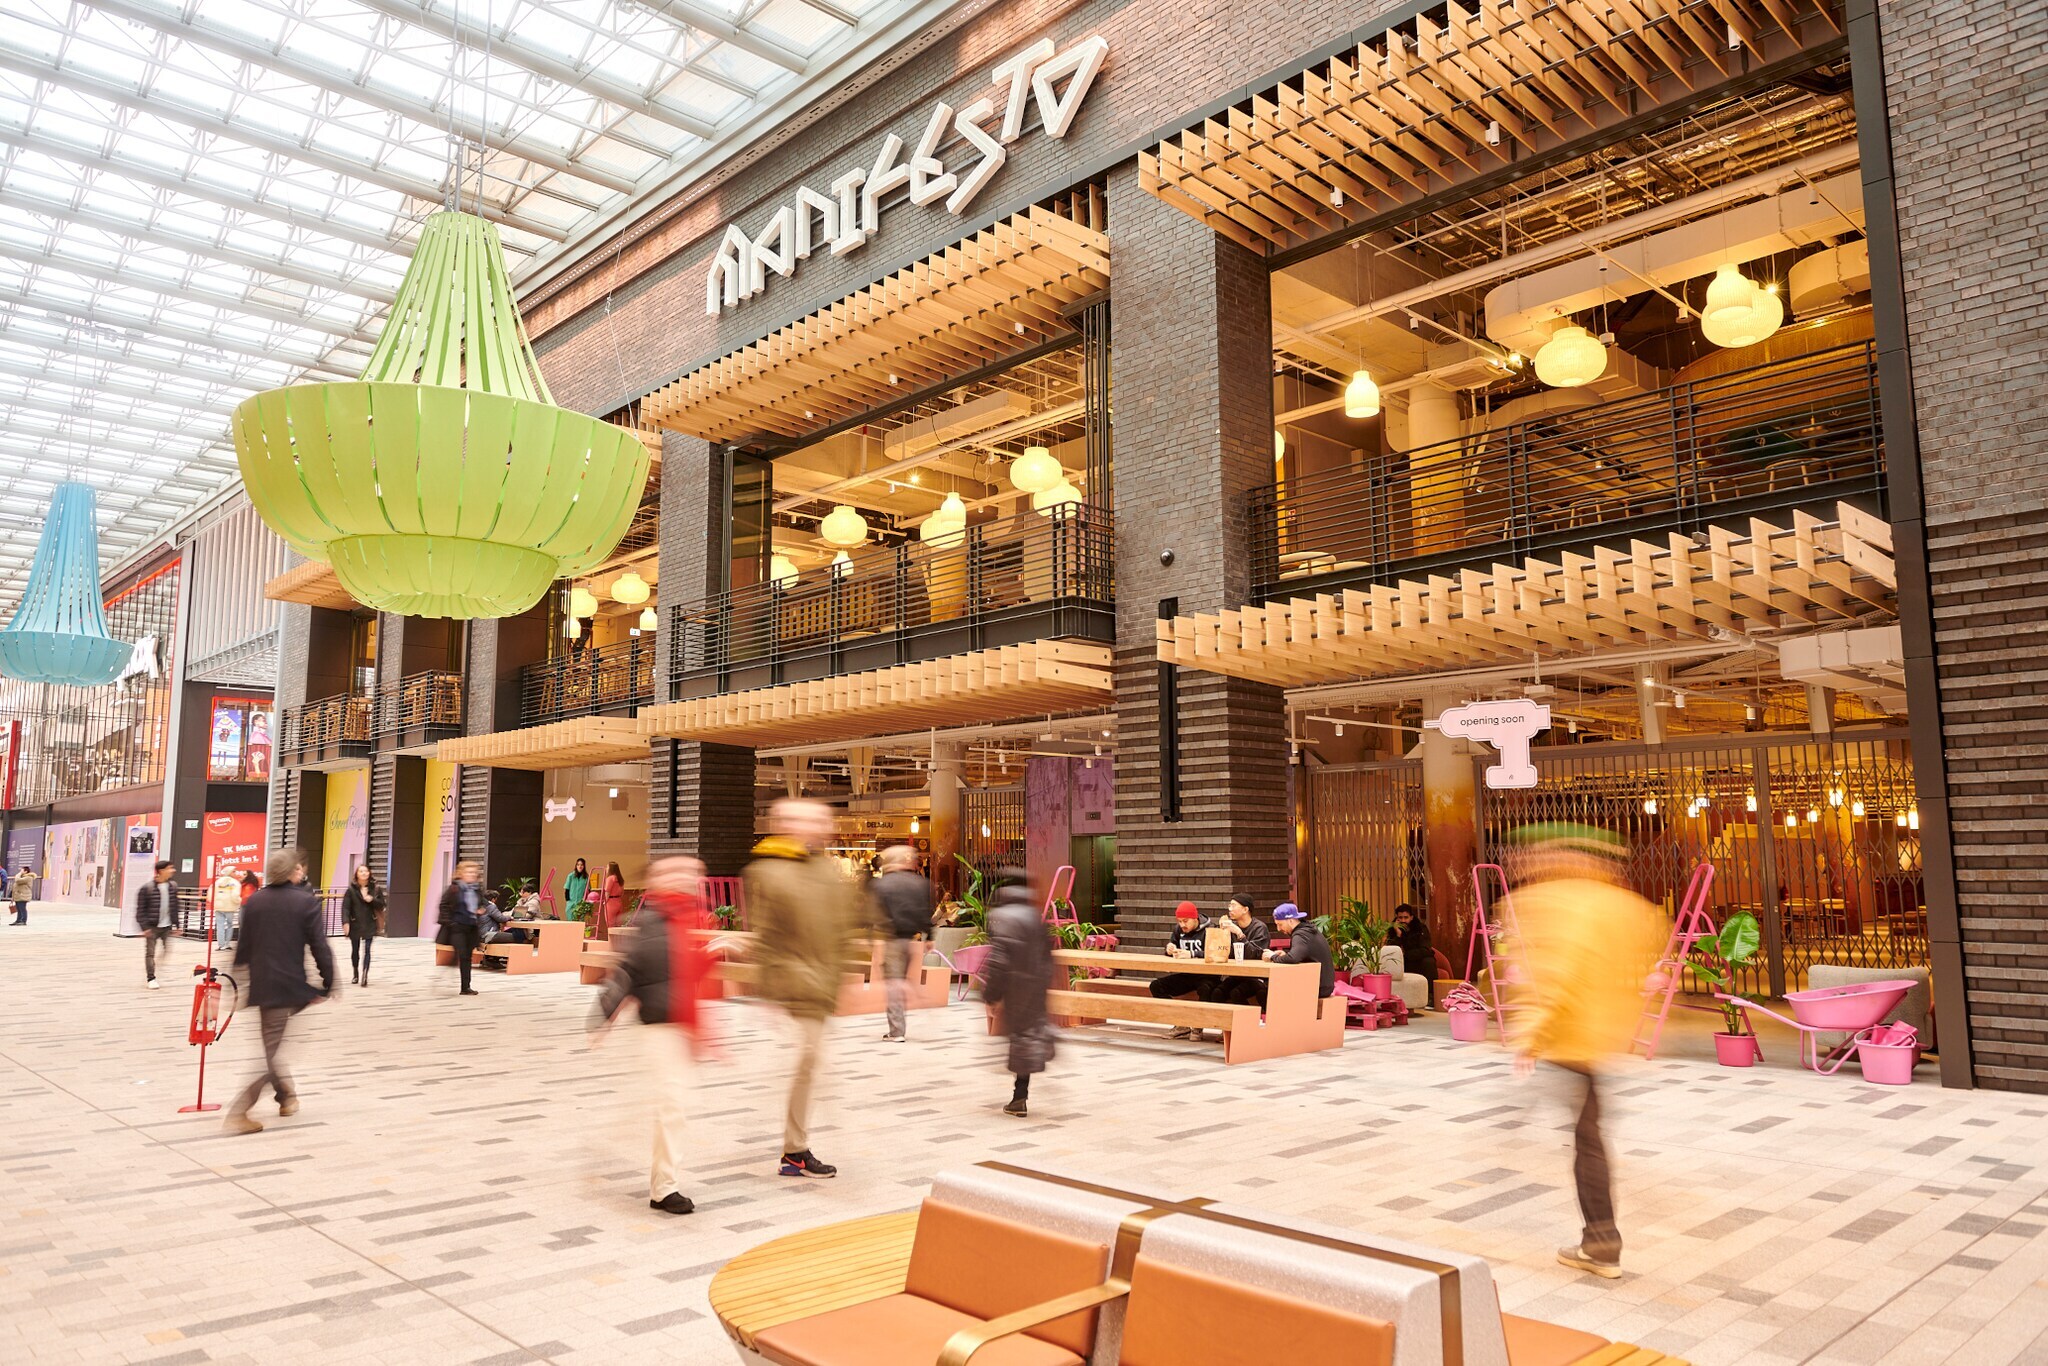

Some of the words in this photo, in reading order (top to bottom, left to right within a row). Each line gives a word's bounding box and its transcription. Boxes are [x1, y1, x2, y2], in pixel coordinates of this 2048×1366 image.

[706, 34, 1109, 317] MANIFESTO
[1460, 716, 1499, 727] opening
[1501, 715, 1524, 723] soon
[441, 778, 456, 791] CO
[222, 846, 234, 854] TK
[236, 844, 258, 852] Maxx
